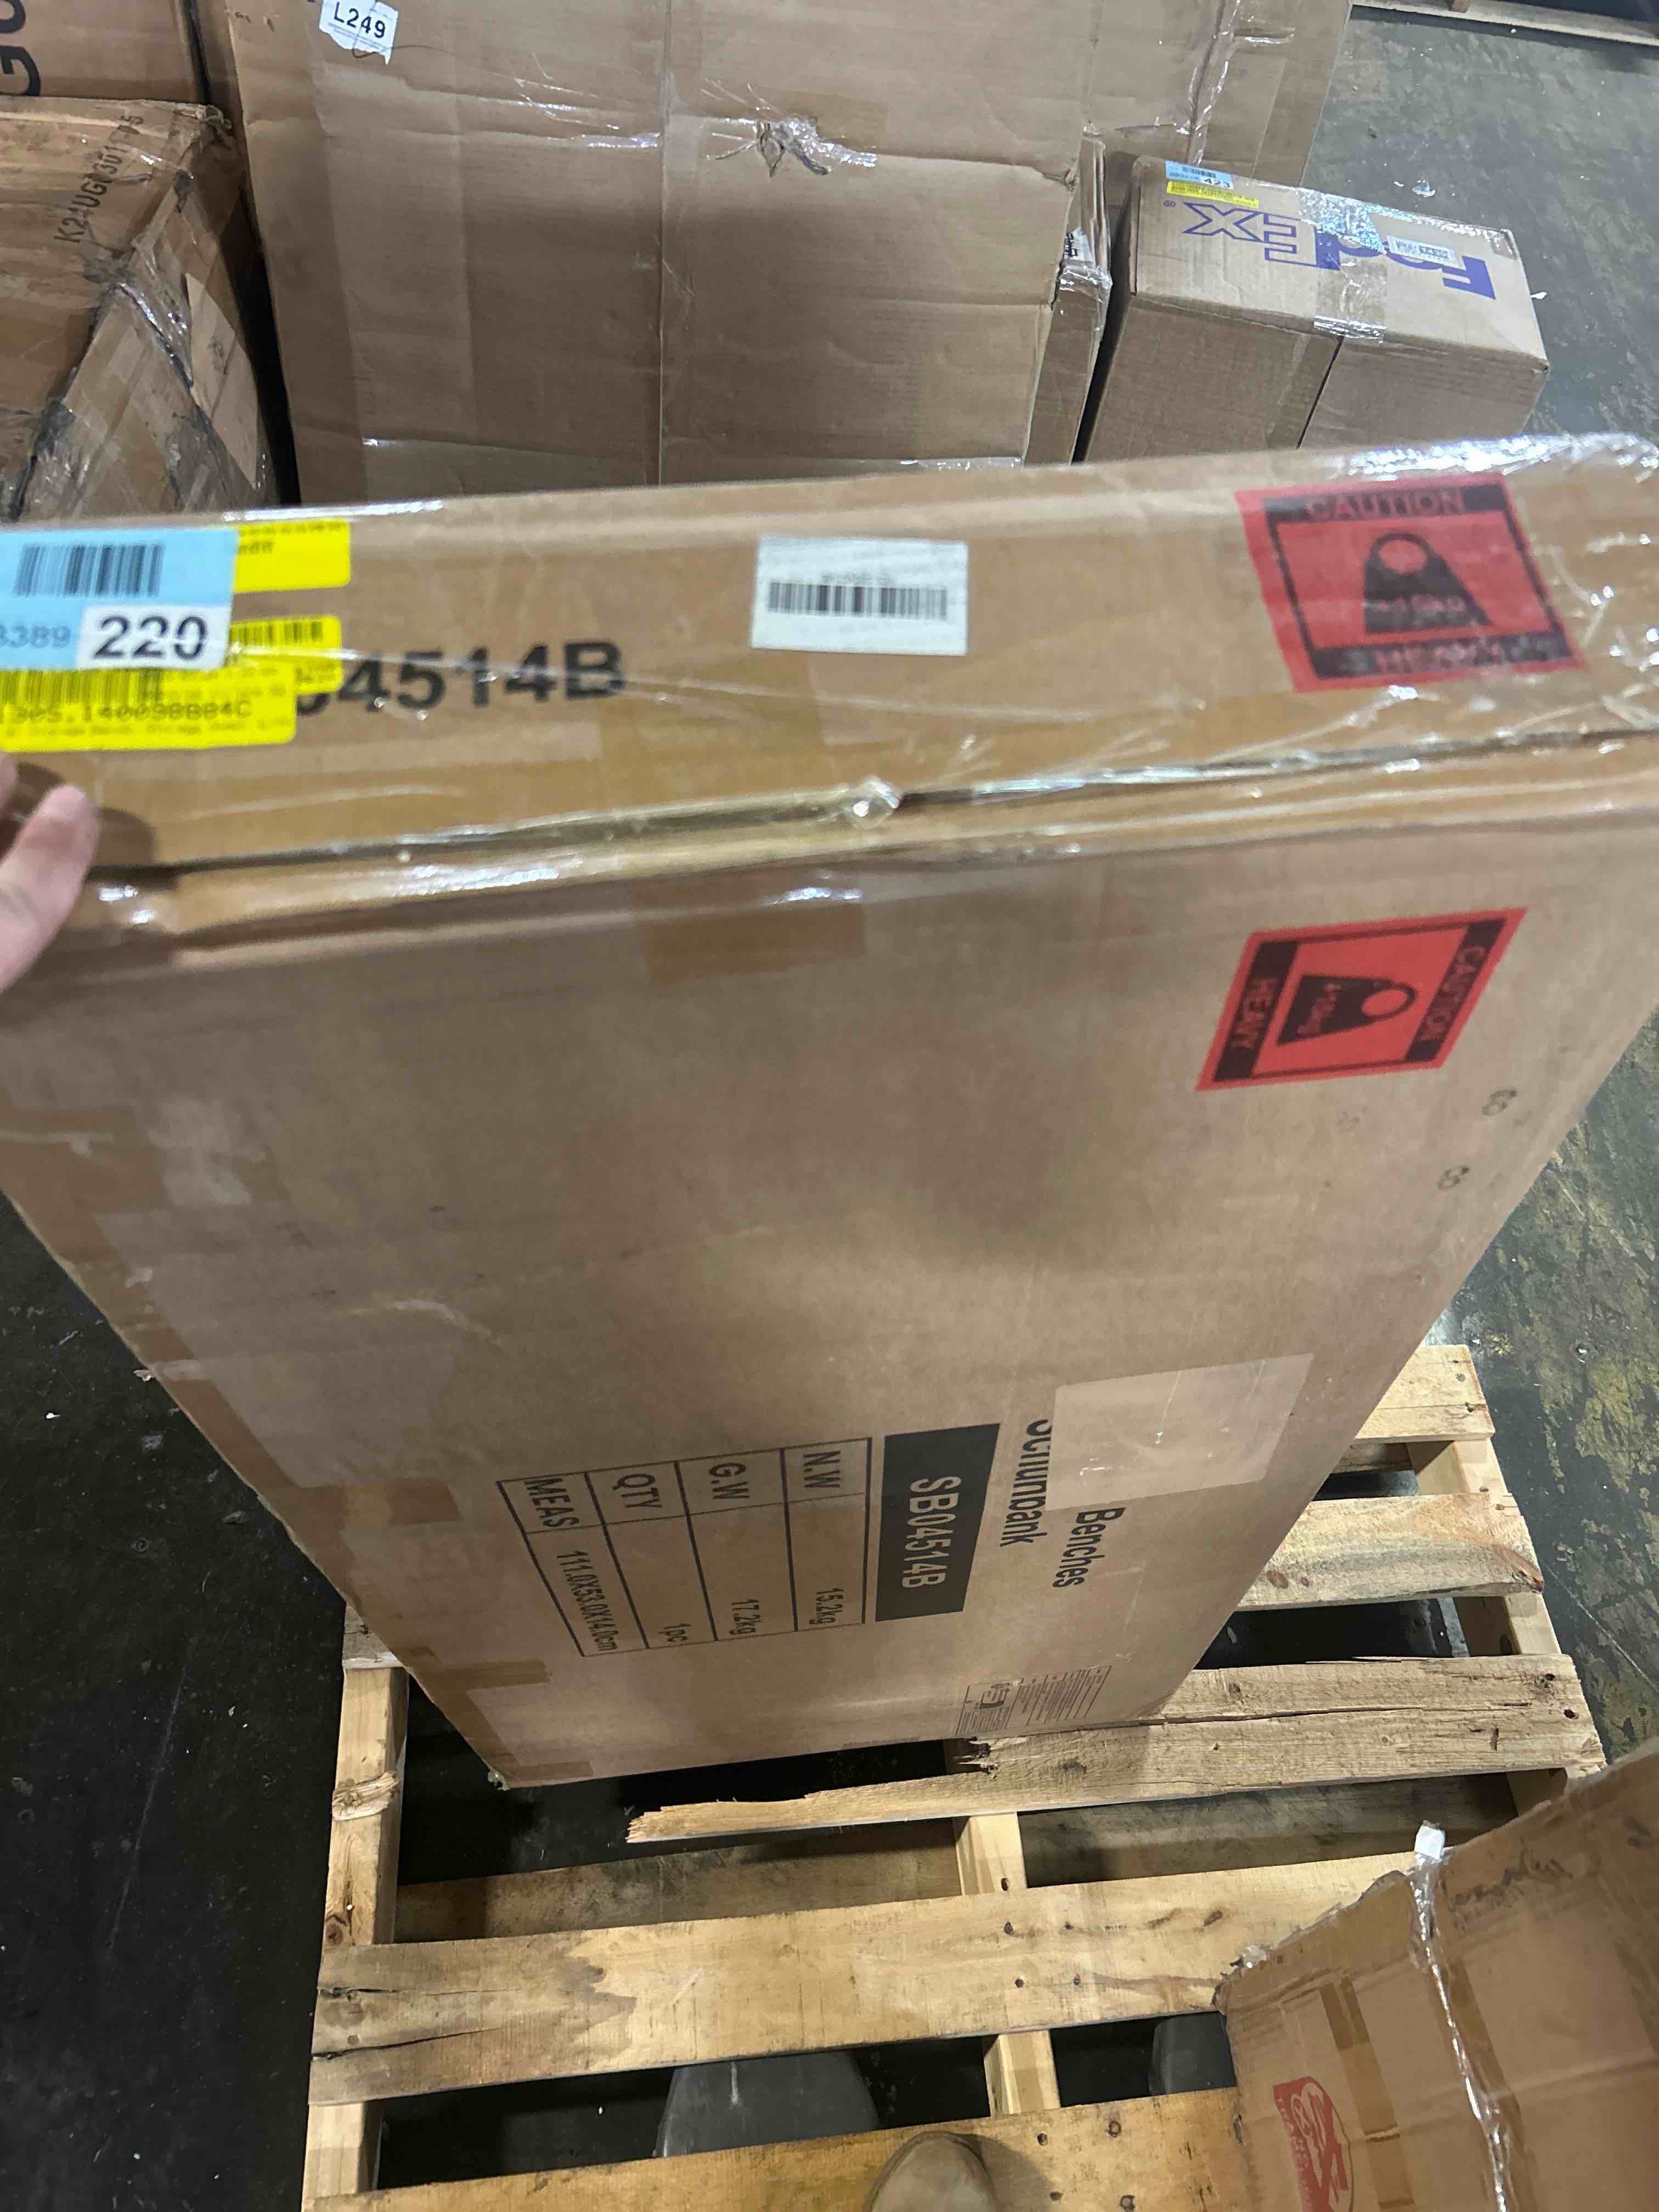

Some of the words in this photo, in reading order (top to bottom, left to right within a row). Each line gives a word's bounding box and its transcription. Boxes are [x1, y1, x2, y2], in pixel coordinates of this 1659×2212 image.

[334, 2, 386, 38] L249
[1306, 488, 1464, 521] CAUTION
[93, 615, 208, 660] 220
[1232, 976, 1276, 1050] HEAVY
[1418, 946, 1487, 1042] CAUTION
[709, 1462, 751, 1502] G.W
[803, 1449, 842, 1489] N.W
[523, 1476, 580, 1530] MEAS
[901, 1475, 961, 1589] SB04514B
[1052, 1507, 1126, 1589] Benches
[612, 1472, 663, 1510] QTY
[657, 1622, 692, 1644] 1pc
[728, 1598, 760, 1635] 17.2kg
[809, 1588, 844, 1626] 15.2kg
